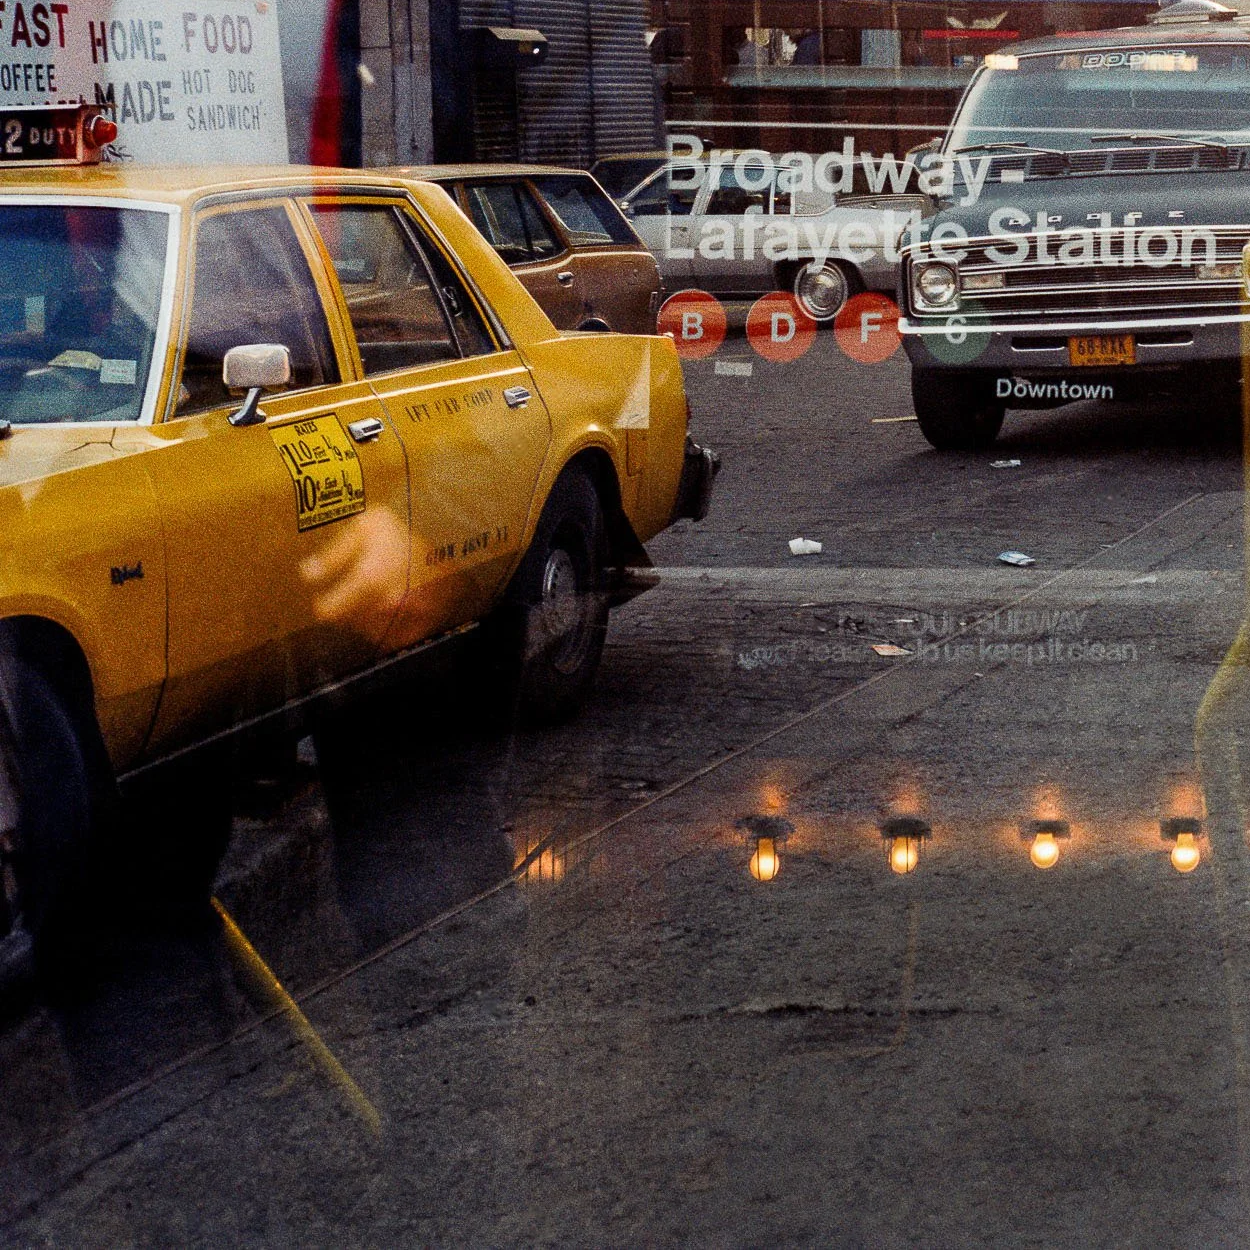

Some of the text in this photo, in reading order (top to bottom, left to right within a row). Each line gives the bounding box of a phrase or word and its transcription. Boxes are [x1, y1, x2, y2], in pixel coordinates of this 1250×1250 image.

[88, 18, 167, 64] HOME
[181, 11, 253, 54] FOOD
[0, 63, 58, 93] OFFEE
[182, 68, 255, 95] HOT DOG
[93, 80, 175, 125] MADE
[187, 104, 261, 131] SANDWICH
[29, 126, 77, 146] DUTY
[666, 134, 1025, 207] Broadway-
[665, 206, 1217, 274] Lafayette Station
[682, 312, 704, 340] B
[770, 312, 796, 343] D
[860, 312, 883, 343] F
[945, 316, 968, 345] 6
[996, 378, 1114, 399] Downtown
[294, 421, 318, 437] RATES
